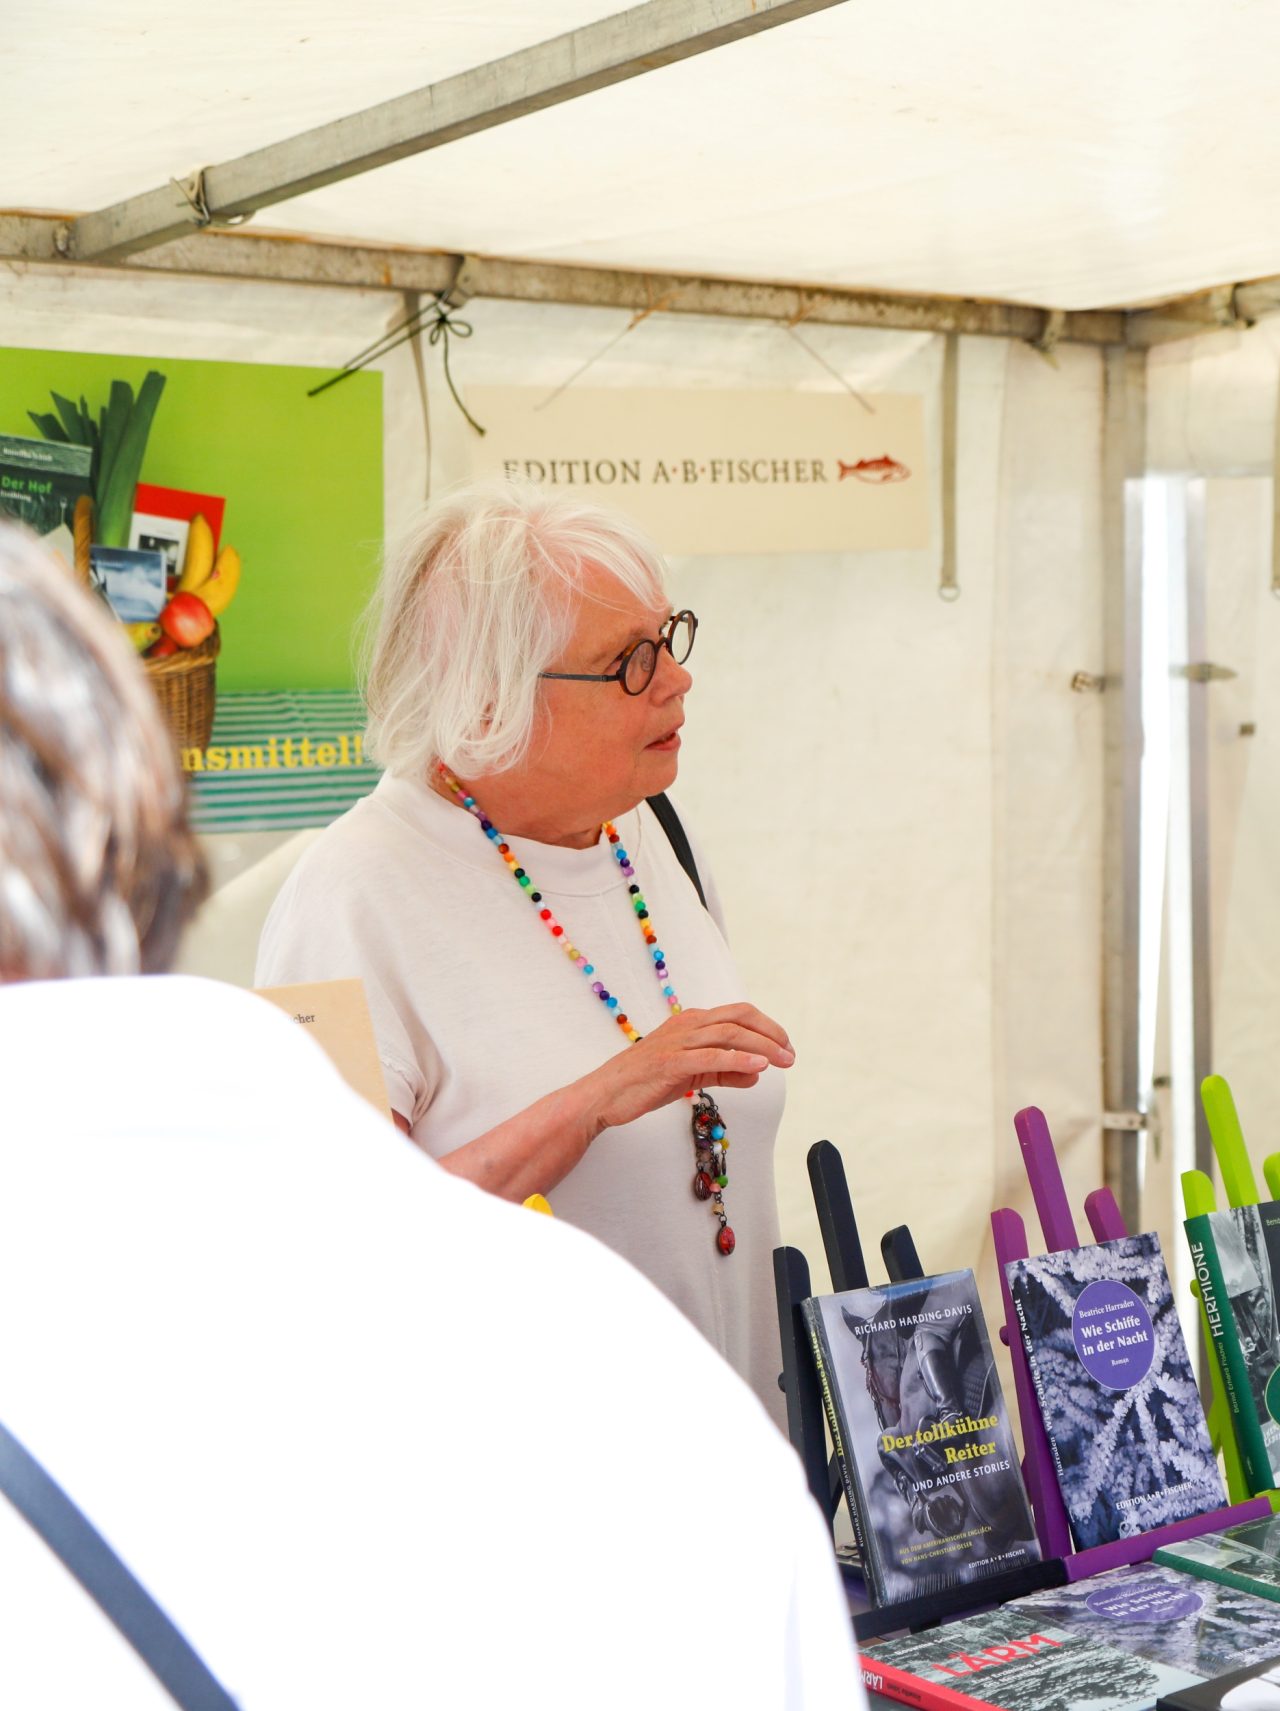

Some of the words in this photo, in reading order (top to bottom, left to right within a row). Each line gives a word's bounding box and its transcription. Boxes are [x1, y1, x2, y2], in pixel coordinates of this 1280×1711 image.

[503, 459, 642, 485] EDITION
[2, 476, 25, 490] Der
[28, 481, 53, 494] Hof
[1266, 1217, 1280, 1227] Bernd
[1191, 1241, 1224, 1337] HERMIONE
[854, 1318, 897, 1336] RICHARD
[899, 1311, 942, 1328] HARDING
[944, 1304, 973, 1319] DAVIS
[1014, 1298, 1028, 1331] Nacht
[1079, 1306, 1105, 1319] Beatrice
[1104, 1300, 1135, 1313] Harraden
[1081, 1324, 1103, 1339] Wie
[1104, 1315, 1141, 1332] Schiffe
[811, 1331, 825, 1368] Reiter
[1024, 1333, 1034, 1353] der
[1082, 1344, 1095, 1356] in
[1096, 1338, 1115, 1353] der
[1117, 1329, 1149, 1349] Nacht
[1029, 1355, 1036, 1367] in
[1111, 1357, 1130, 1367] Roman
[1032, 1368, 1048, 1408] Schiffe
[1042, 1408, 1053, 1431] Wie
[835, 1433, 844, 1457] Der
[881, 1434, 913, 1454] Der
[914, 1415, 999, 1443] tollkühne
[944, 1441, 997, 1464] Reiter
[1050, 1436, 1064, 1477] Harraden
[841, 1463, 851, 1484] DAVIS
[912, 1478, 934, 1493] UND
[936, 1470, 972, 1487] ANDERE
[973, 1460, 1010, 1477] STORIES
[1115, 1494, 1148, 1511] EDITION
[853, 1517, 864, 1547] RICHARD
[900, 1547, 910, 1555] AUS
[910, 1544, 923, 1552] DEM
[923, 1533, 967, 1549] AMERIKANISCHEN
[967, 1525, 993, 1538] ENGLISCH
[901, 1557, 913, 1565] VON
[913, 1546, 957, 1561] HANS-CHRISTIAN
[957, 1542, 973, 1552] OESER
[968, 1559, 990, 1569] EDITION
[1103, 1600, 1131, 1612] Wie
[1134, 1589, 1173, 1603] Schiffe
[1112, 1609, 1129, 1618] in
[1129, 1602, 1151, 1614] der
[1152, 1592, 1189, 1606] Nacht
[931, 1632, 1065, 1678] LÄRM
